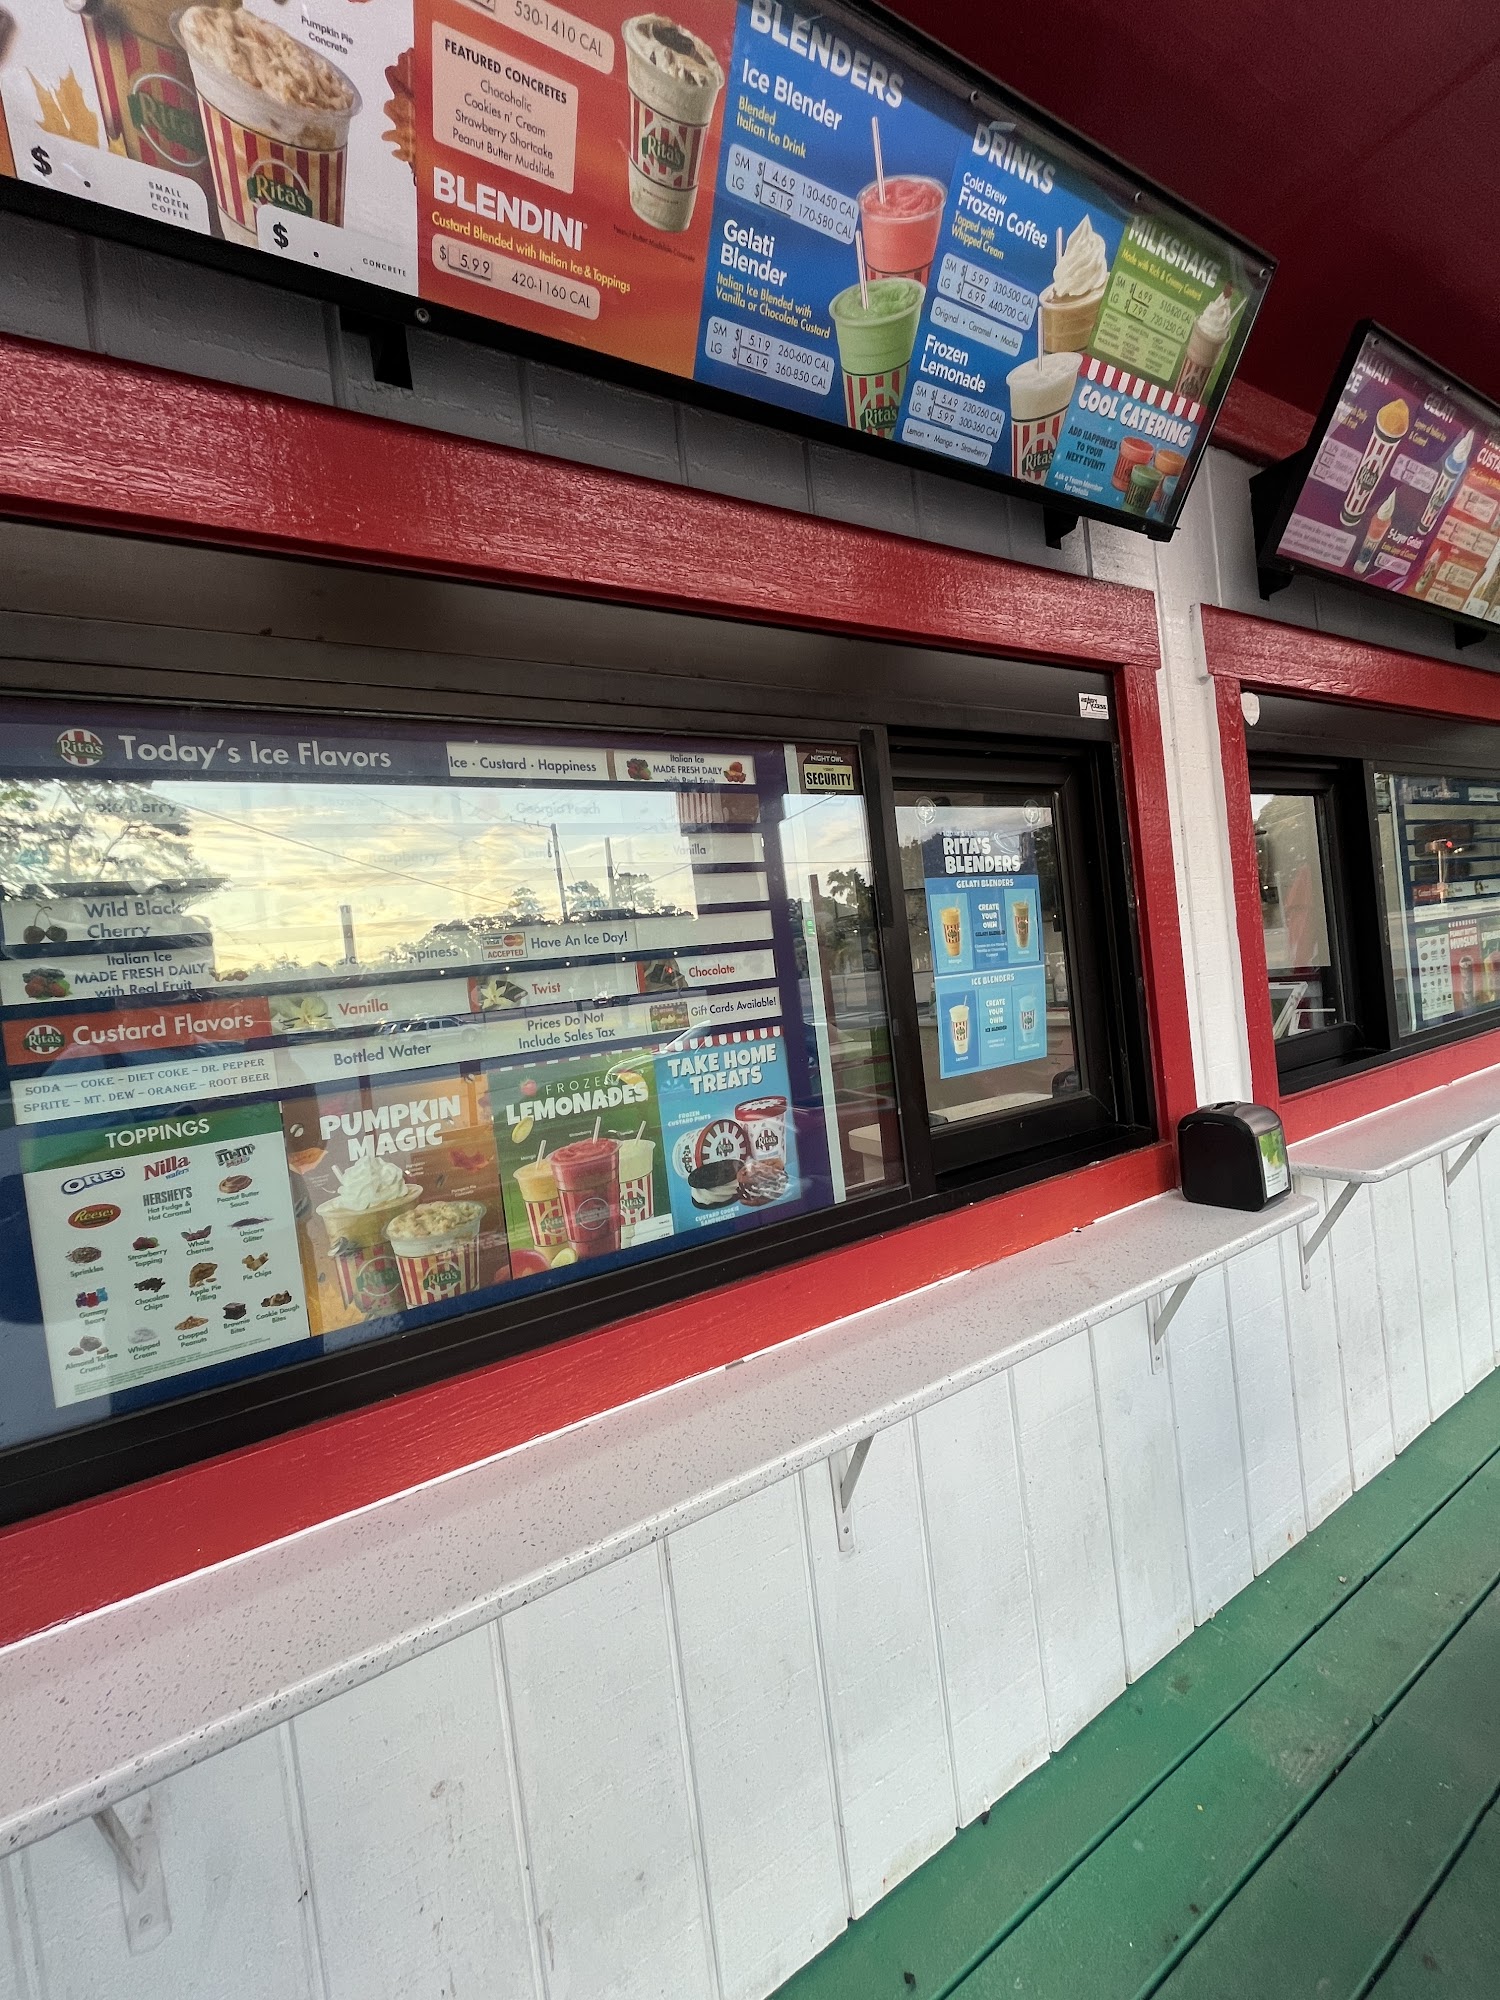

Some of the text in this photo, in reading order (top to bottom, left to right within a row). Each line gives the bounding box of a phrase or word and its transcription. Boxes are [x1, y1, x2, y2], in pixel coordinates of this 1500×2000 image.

[301, 15, 354, 45] Pumpkin Pie
[514, 1, 603, 58] 530-1410 CAL
[308, 32, 348, 54] Concrete
[750, 0, 904, 109] BLENDERS
[444, 39, 567, 104] FEATURED CONCRETES
[480, 79, 532, 113] Chocoholic
[742, 59, 843, 130] Ice Blender
[464, 93, 501, 120] Cookies
[516, 116, 546, 138] Cream
[738, 96, 776, 126] Blended
[455, 109, 554, 160] Strawberry Shortcake
[736, 113, 807, 158] Italian Ice Drink
[452, 127, 555, 179] Peanut Butter Mudslide
[972, 123, 1056, 195] DRINKS
[148, 181, 181, 198] SMALL
[254, 176, 308, 213] Rita's
[963, 171, 1007, 206] Cold Brew
[150, 192, 190, 212] FROZEN
[151, 203, 190, 220] COFFEE
[433, 166, 583, 251] BLENDINI
[954, 211, 995, 240] Topped with
[958, 186, 1048, 249] Frozen Coffee
[723, 219, 775, 258] Gelati
[952, 224, 1005, 260] Whipped Cream
[431, 212, 631, 293] Custard Blended with Italian Ice & Toppings
[720, 242, 788, 287] Blender
[1128, 215, 1222, 289] MILKSHAKE
[363, 258, 407, 277] CONCRETE
[461, 254, 591, 309] 5.99 420-1160 CAL
[716, 286, 831, 339] Vanilla or Chocolate Custard
[935, 306, 1019, 349] Original Caramel Mocha
[924, 333, 969, 367] Frozen
[920, 354, 986, 393] Lemonade
[1078, 385, 1192, 448] COOL CATERING
[906, 425, 988, 459] Lemon Mango Strawberry
[1068, 425, 1117, 449] ADD HAPPINESS
[1066, 450, 1105, 471] NEXT EVENT!
[1076, 442, 1103, 458] TO YOUR
[58, 738, 104, 756] Rita's
[118, 734, 392, 769] Today's Ice Flavors
[670, 754, 705, 764] Italian Ice
[449, 756, 597, 774] Ice Custard Happiness
[653, 764, 723, 776] MADE FRESH DAILY
[806, 772, 851, 785] SECURITY
[943, 837, 991, 856] RITA'S
[945, 856, 1021, 874] BLENDERS
[956, 878, 1014, 889] GELATI BLENDERS
[84, 904, 132, 918] Wild
[978, 903, 999, 911] CREATE
[982, 912, 998, 920] YOUR
[87, 923, 151, 939] Cherry
[983, 921, 998, 929] OWN
[531, 931, 628, 949] Have An Ice Day!
[106, 951, 172, 966] Italian Ice
[488, 949, 524, 958] ACCEPTED
[74, 962, 206, 985] MADE FRESH DAILY
[688, 964, 735, 978] Chocolate
[972, 974, 1014, 986] ICE BLENDERS
[532, 982, 561, 995] Twist
[338, 999, 389, 1016] Vanilla
[690, 996, 777, 1017] Gift Cards Available!
[986, 998, 1006, 1007] CREATE
[989, 1008, 1004, 1016] YOUR
[72, 1014, 254, 1046] Custard Flavors
[527, 1012, 604, 1032] Prices Do Not
[989, 1016, 1004, 1024] OWN
[518, 1027, 616, 1049] Include Sales Tax
[333, 1042, 432, 1067] Bottled Water
[667, 1043, 777, 1078] TAKE HOME
[25, 1058, 265, 1097] SODA COKE DIET COKE DR. PEPPER
[689, 1067, 763, 1096] TREATS
[24, 1072, 270, 1113] SPRITE MT. DEW ORANGE ROOT BEER
[506, 1081, 649, 1123] LEMONADES
[319, 1095, 461, 1141] PUMPKIN
[678, 1111, 700, 1119] FROZEN
[105, 1118, 210, 1149] TOPPINGS
[348, 1123, 444, 1162] MAGIC
[144, 1156, 190, 1181] Nilla
[61, 1168, 125, 1196] OREO
[142, 1186, 192, 1207] HERSHEY'S
[70, 1265, 104, 1278] Sprinkles
[135, 1293, 170, 1306] Chocolate
